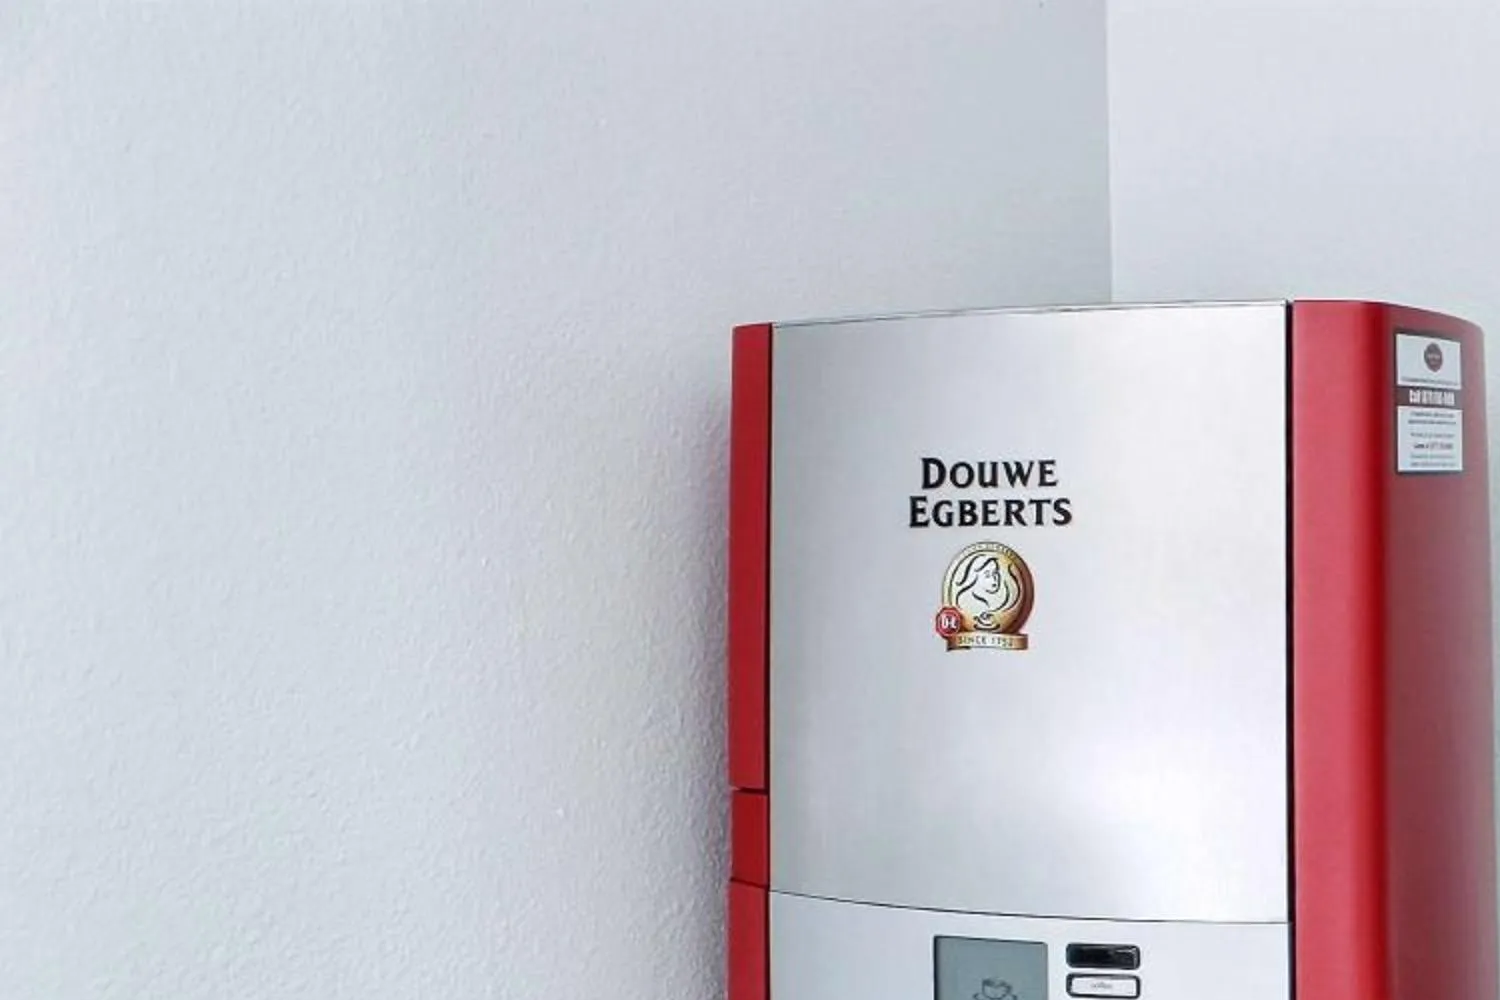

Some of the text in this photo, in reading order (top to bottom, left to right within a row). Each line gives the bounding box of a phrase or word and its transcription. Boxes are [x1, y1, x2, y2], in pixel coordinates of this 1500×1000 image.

[921, 457, 1058, 490] DOUWE
[909, 495, 1073, 528] EGBERTS
[959, 635, 987, 646] SINCE
